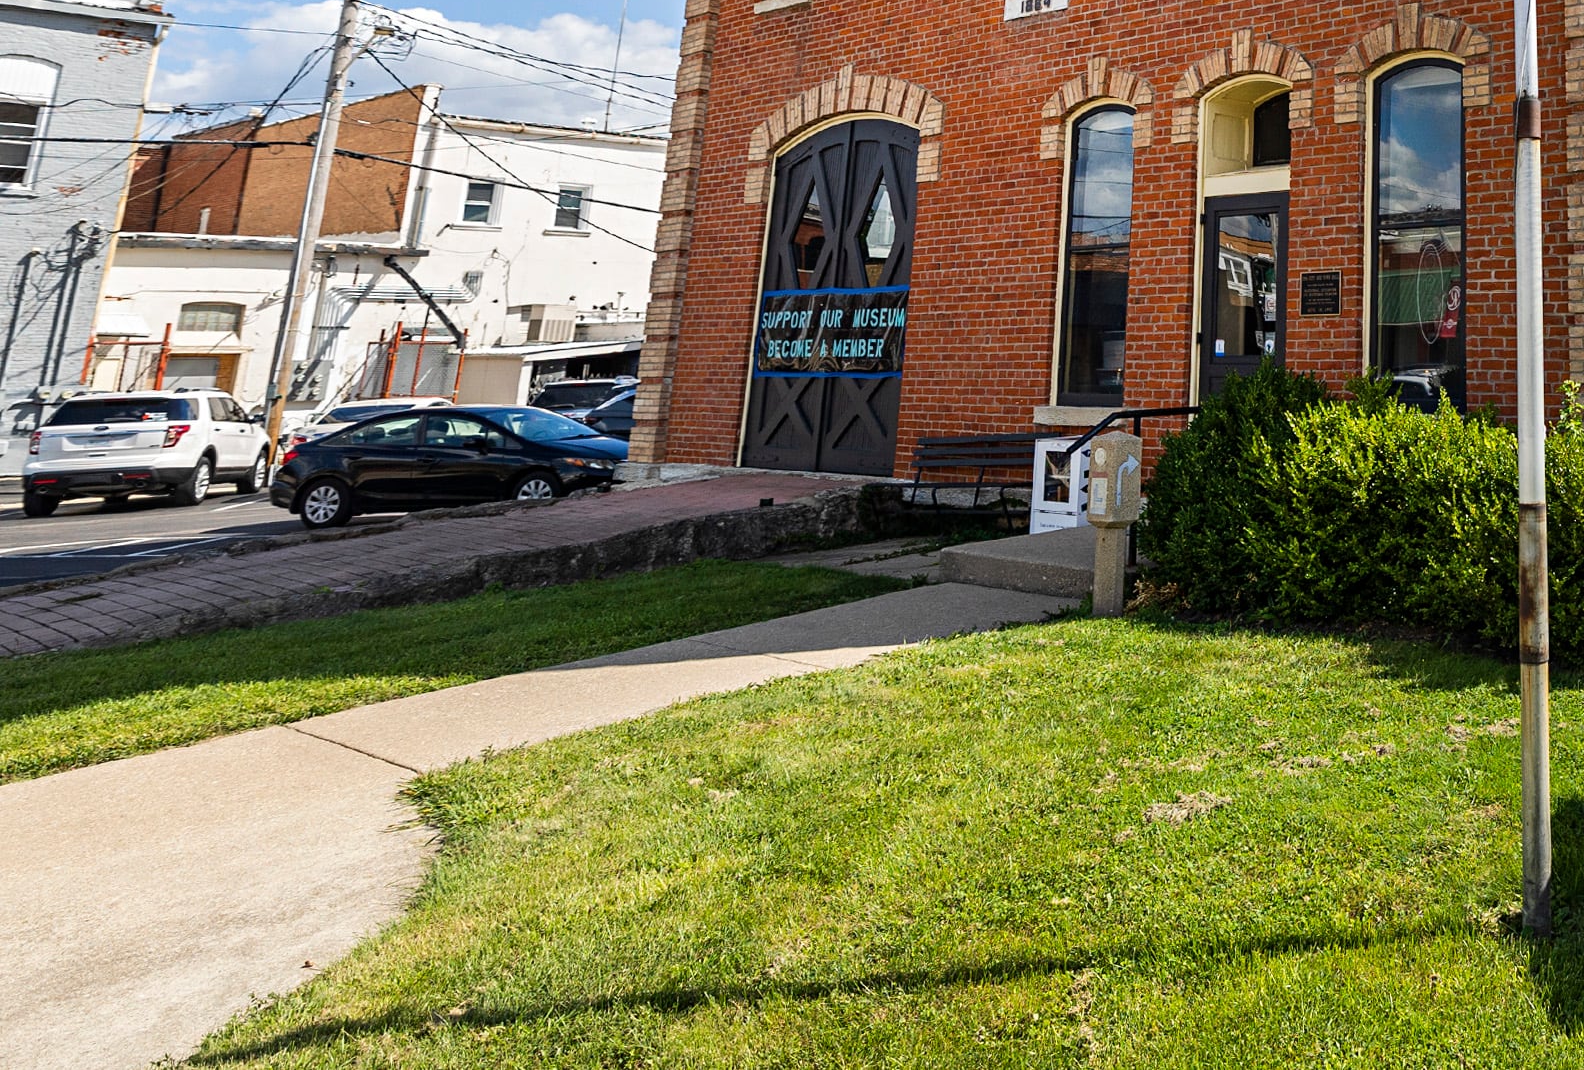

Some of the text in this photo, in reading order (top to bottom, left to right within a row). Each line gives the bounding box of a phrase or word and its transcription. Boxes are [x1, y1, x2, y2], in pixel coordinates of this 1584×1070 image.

[761, 308, 905, 329] SUPPORT OUR MUSEUM
[767, 339, 885, 358] BECOME A MEMBER
